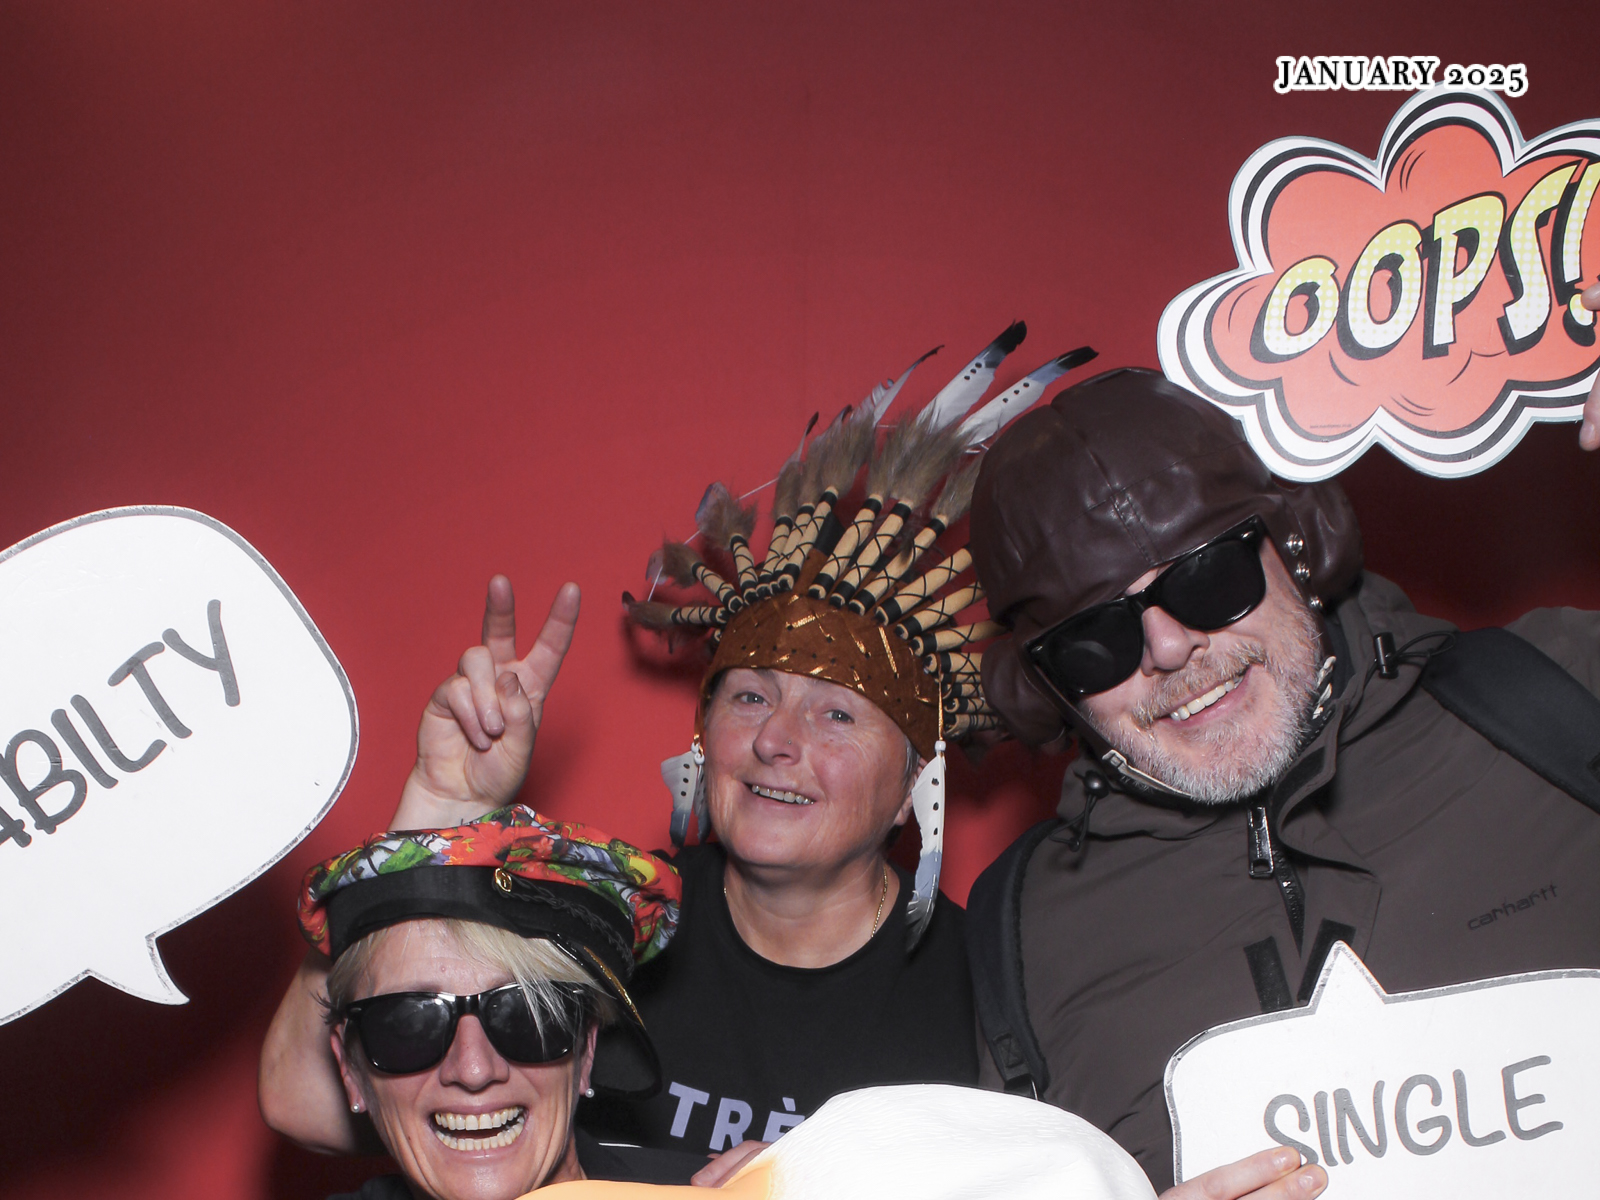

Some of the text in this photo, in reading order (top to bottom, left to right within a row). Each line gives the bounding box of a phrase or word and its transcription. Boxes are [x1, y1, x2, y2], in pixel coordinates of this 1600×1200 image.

[1252, 160, 1600, 362] OOPS!
[1468, 882, 1557, 930] carhartt
[1263, 1055, 1564, 1167] SINGLE
